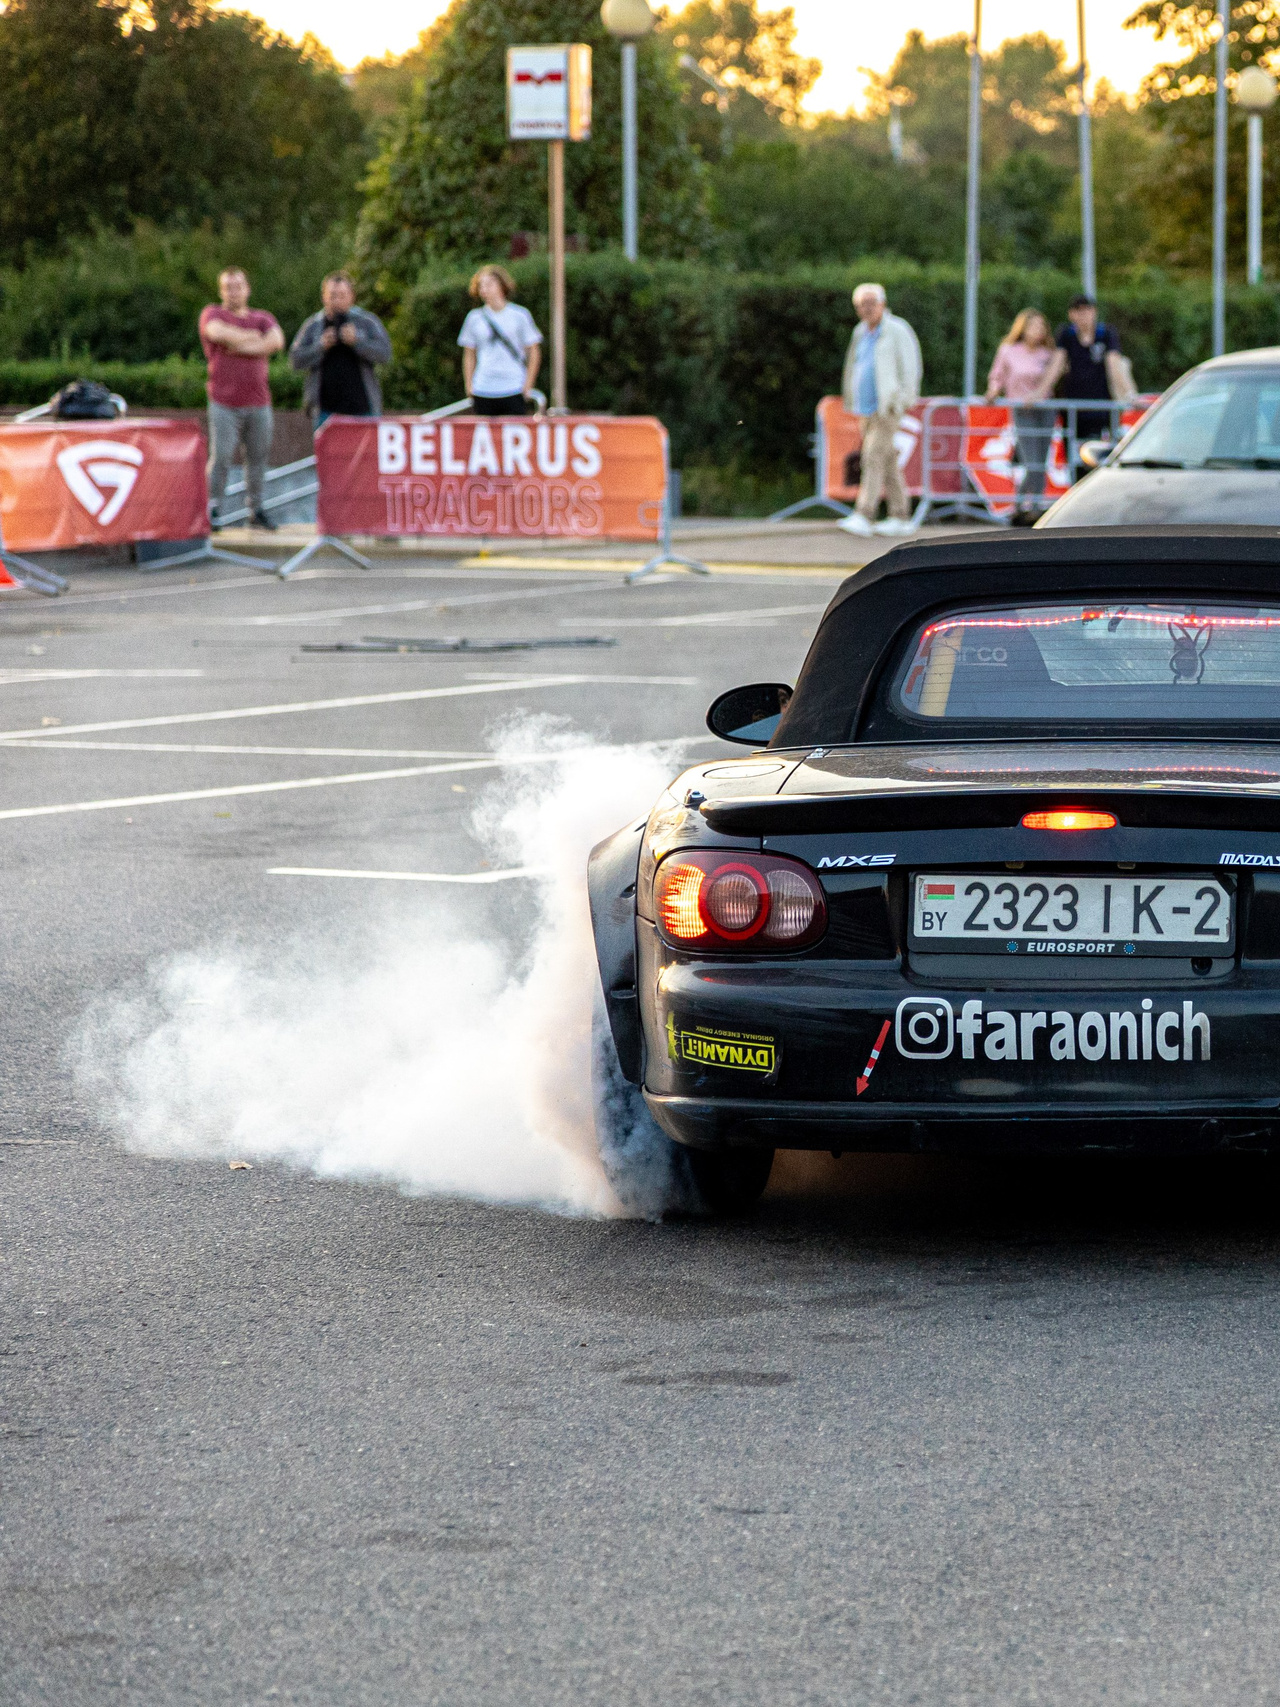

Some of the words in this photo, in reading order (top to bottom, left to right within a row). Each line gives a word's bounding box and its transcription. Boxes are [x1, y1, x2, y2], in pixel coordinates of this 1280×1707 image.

[378, 424, 602, 477] BELARUS
[378, 476, 602, 535] TRACTORS
[817, 853, 897, 868] MX5
[963, 882, 1079, 932] 2323
[922, 911, 948, 931] BY
[1026, 942, 1115, 954] EUROSPORT
[695, 1025, 714, 1034] DRINK
[714, 1029, 741, 1038] ENERGY
[742, 1032, 775, 1042] ORIGINAL
[956, 998, 1211, 1061] faraonich
